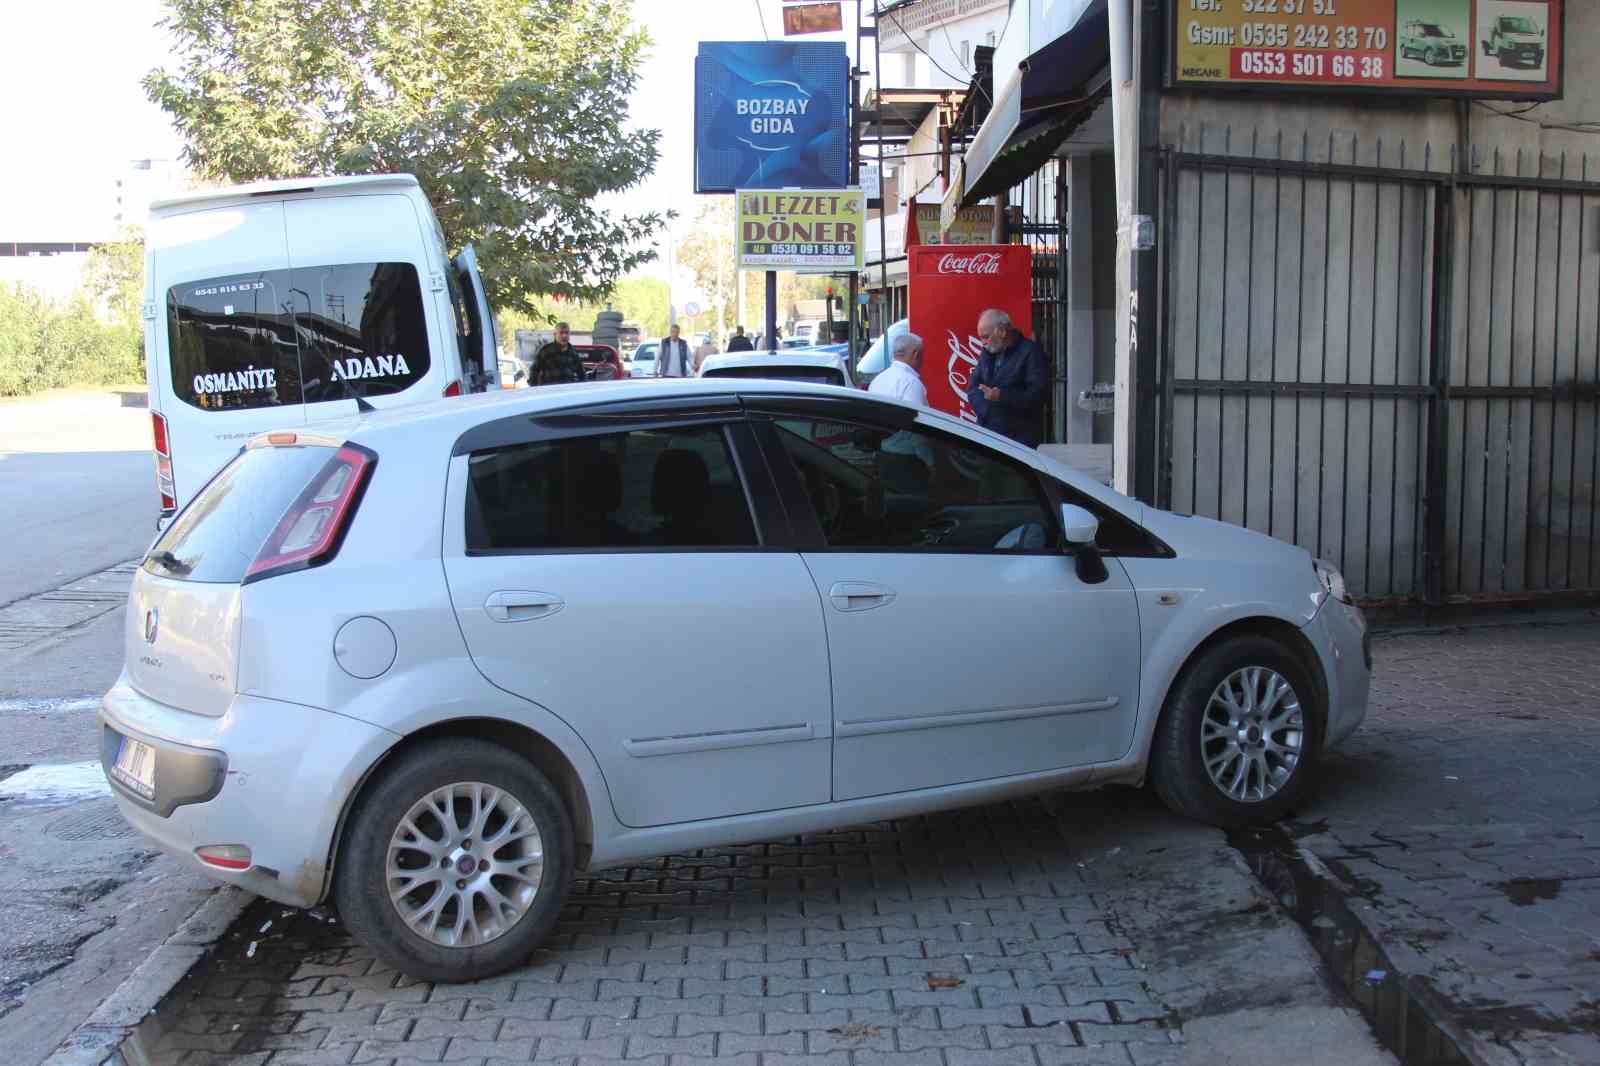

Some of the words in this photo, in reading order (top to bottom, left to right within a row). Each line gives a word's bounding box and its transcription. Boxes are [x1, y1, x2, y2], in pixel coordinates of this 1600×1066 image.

[1241, 22, 1289, 46] 0535
[1295, 24, 1329, 47] 242
[1335, 26, 1359, 48] 33
[1363, 27, 1387, 49] 70
[1241, 51, 1286, 74] 0553
[1292, 53, 1324, 76] 501
[1332, 55, 1355, 77] 66
[1361, 56, 1383, 78] 38
[736, 99, 809, 115] BOZBAY
[751, 118, 795, 134] GIDA
[762, 195, 841, 215] LEZZET
[743, 216, 857, 242] DÖNER
[938, 253, 1003, 274] Coca-Cola
[193, 365, 277, 394] OSMANİYE
[331, 354, 411, 380] ADANA
